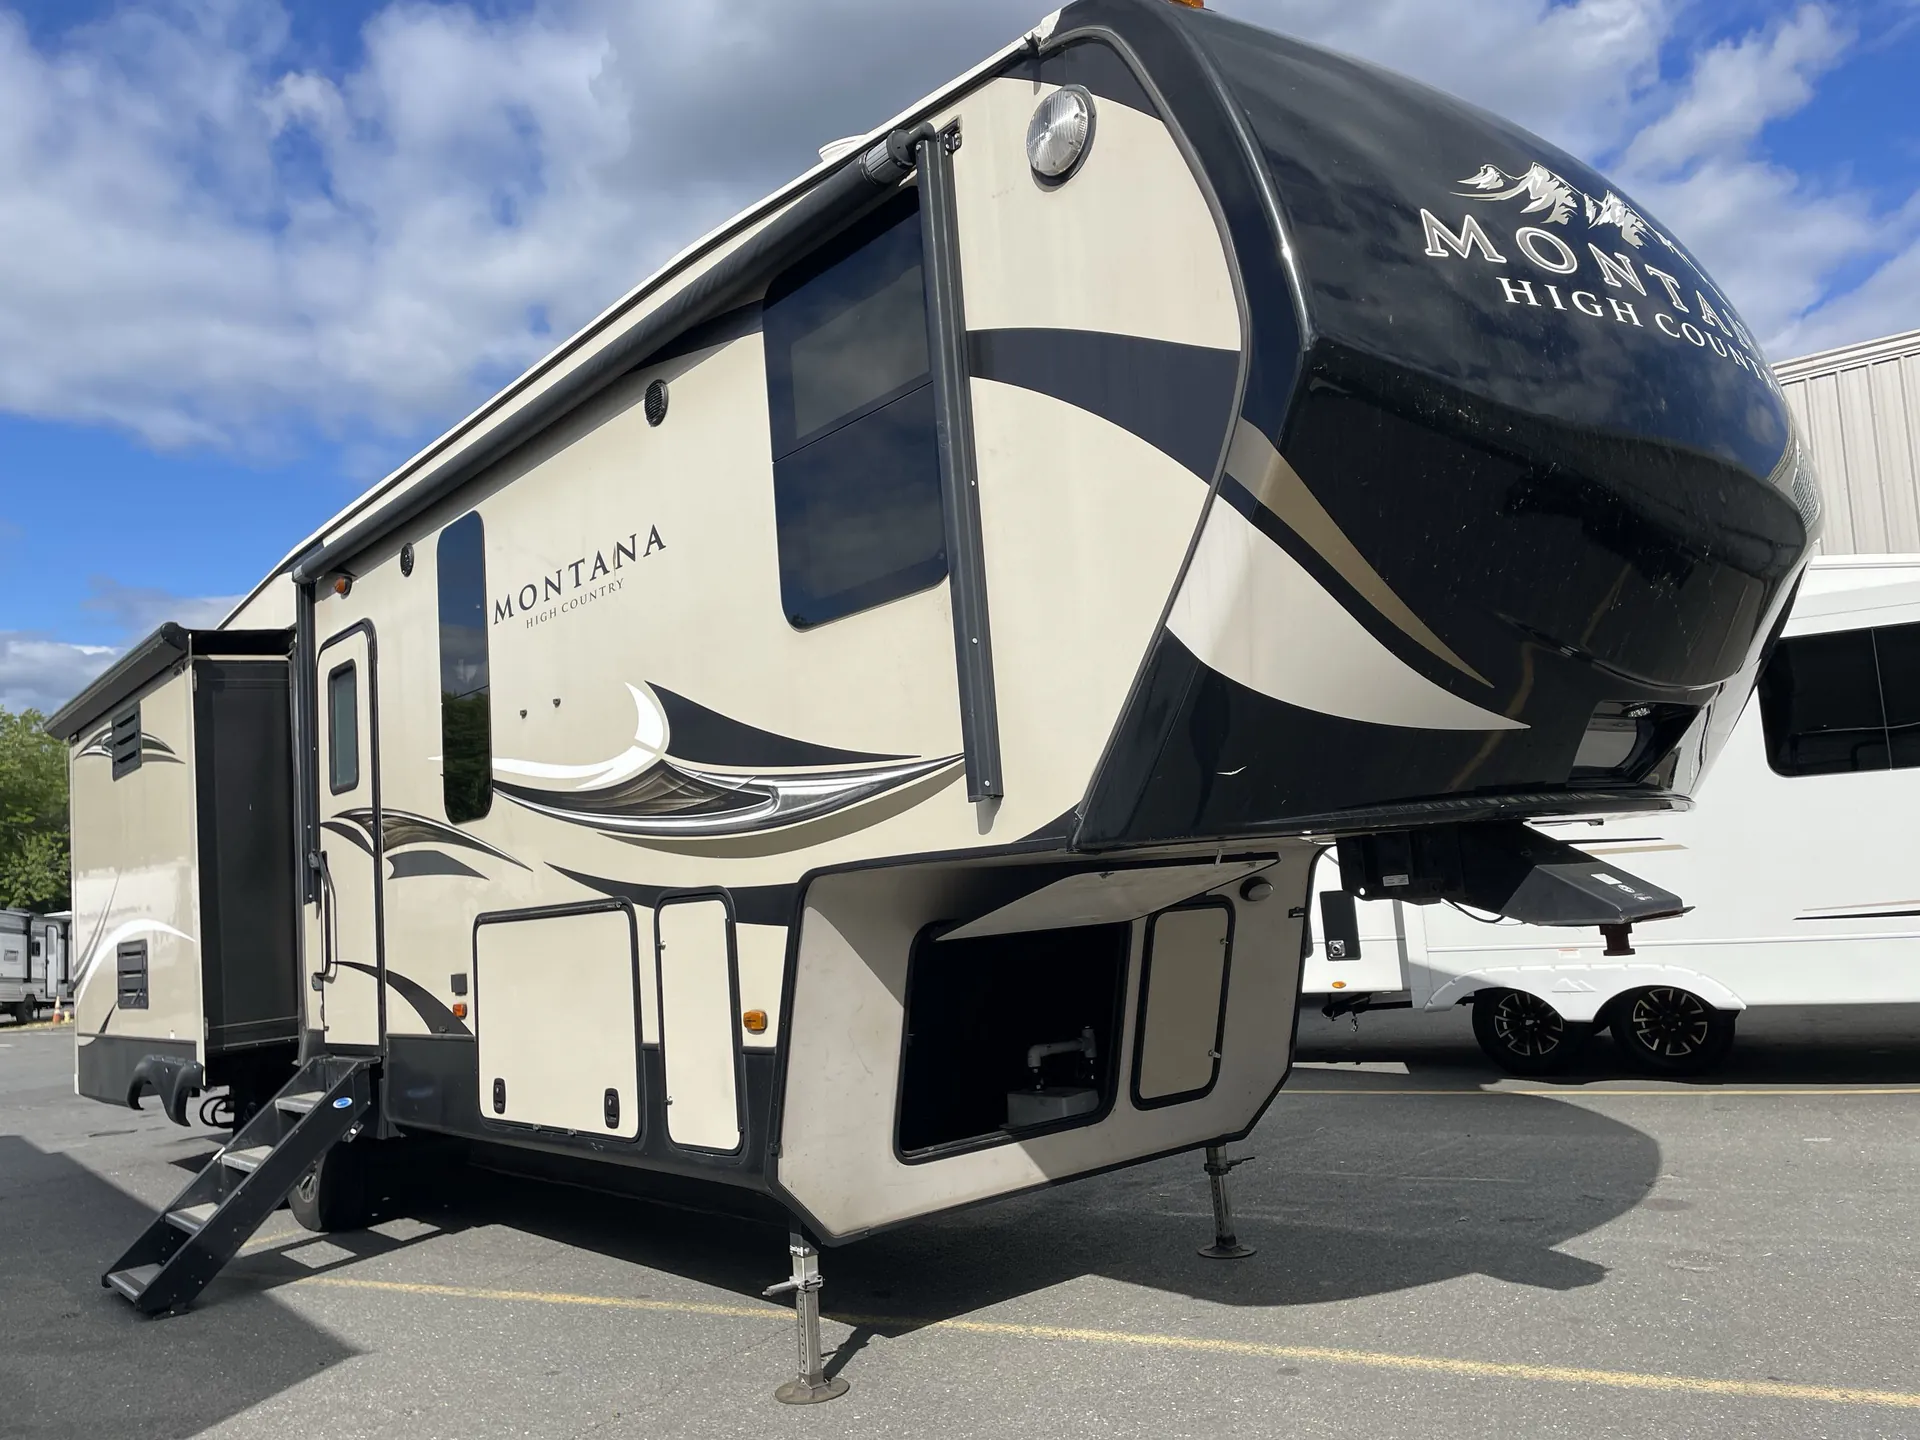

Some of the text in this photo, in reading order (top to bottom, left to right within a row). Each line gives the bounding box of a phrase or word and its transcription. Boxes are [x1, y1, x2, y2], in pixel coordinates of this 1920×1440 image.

[1419, 207, 1767, 368] MONTAN
[1496, 276, 1785, 402] HIGH COUNTR
[493, 523, 667, 625] MONTANA
[526, 578, 624, 629] HIGH COUNTRY
